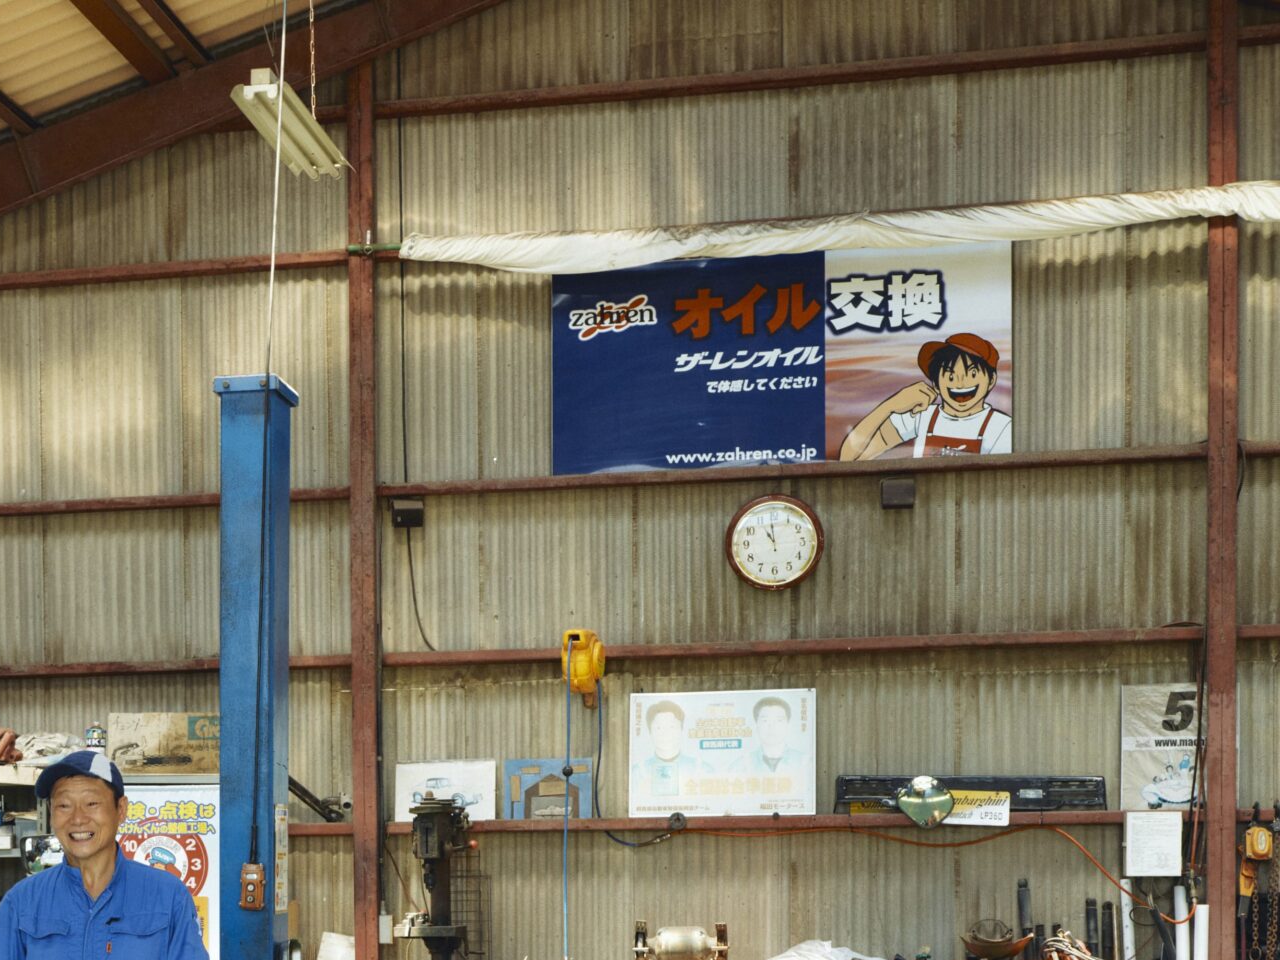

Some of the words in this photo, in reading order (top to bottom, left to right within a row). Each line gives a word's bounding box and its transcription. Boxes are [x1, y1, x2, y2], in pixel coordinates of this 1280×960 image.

[571, 303, 654, 331] zahren
[673, 345, 823, 373] ザーレンオイル
[706, 376, 818, 394] で体感してください
[665, 444, 817, 465] www.zahren.co.jp
[1161, 691, 1197, 731] 5
[123, 839, 138, 853] 10
[185, 838, 197, 851] 2
[190, 858, 202, 871] 3
[185, 876, 197, 889] 4
